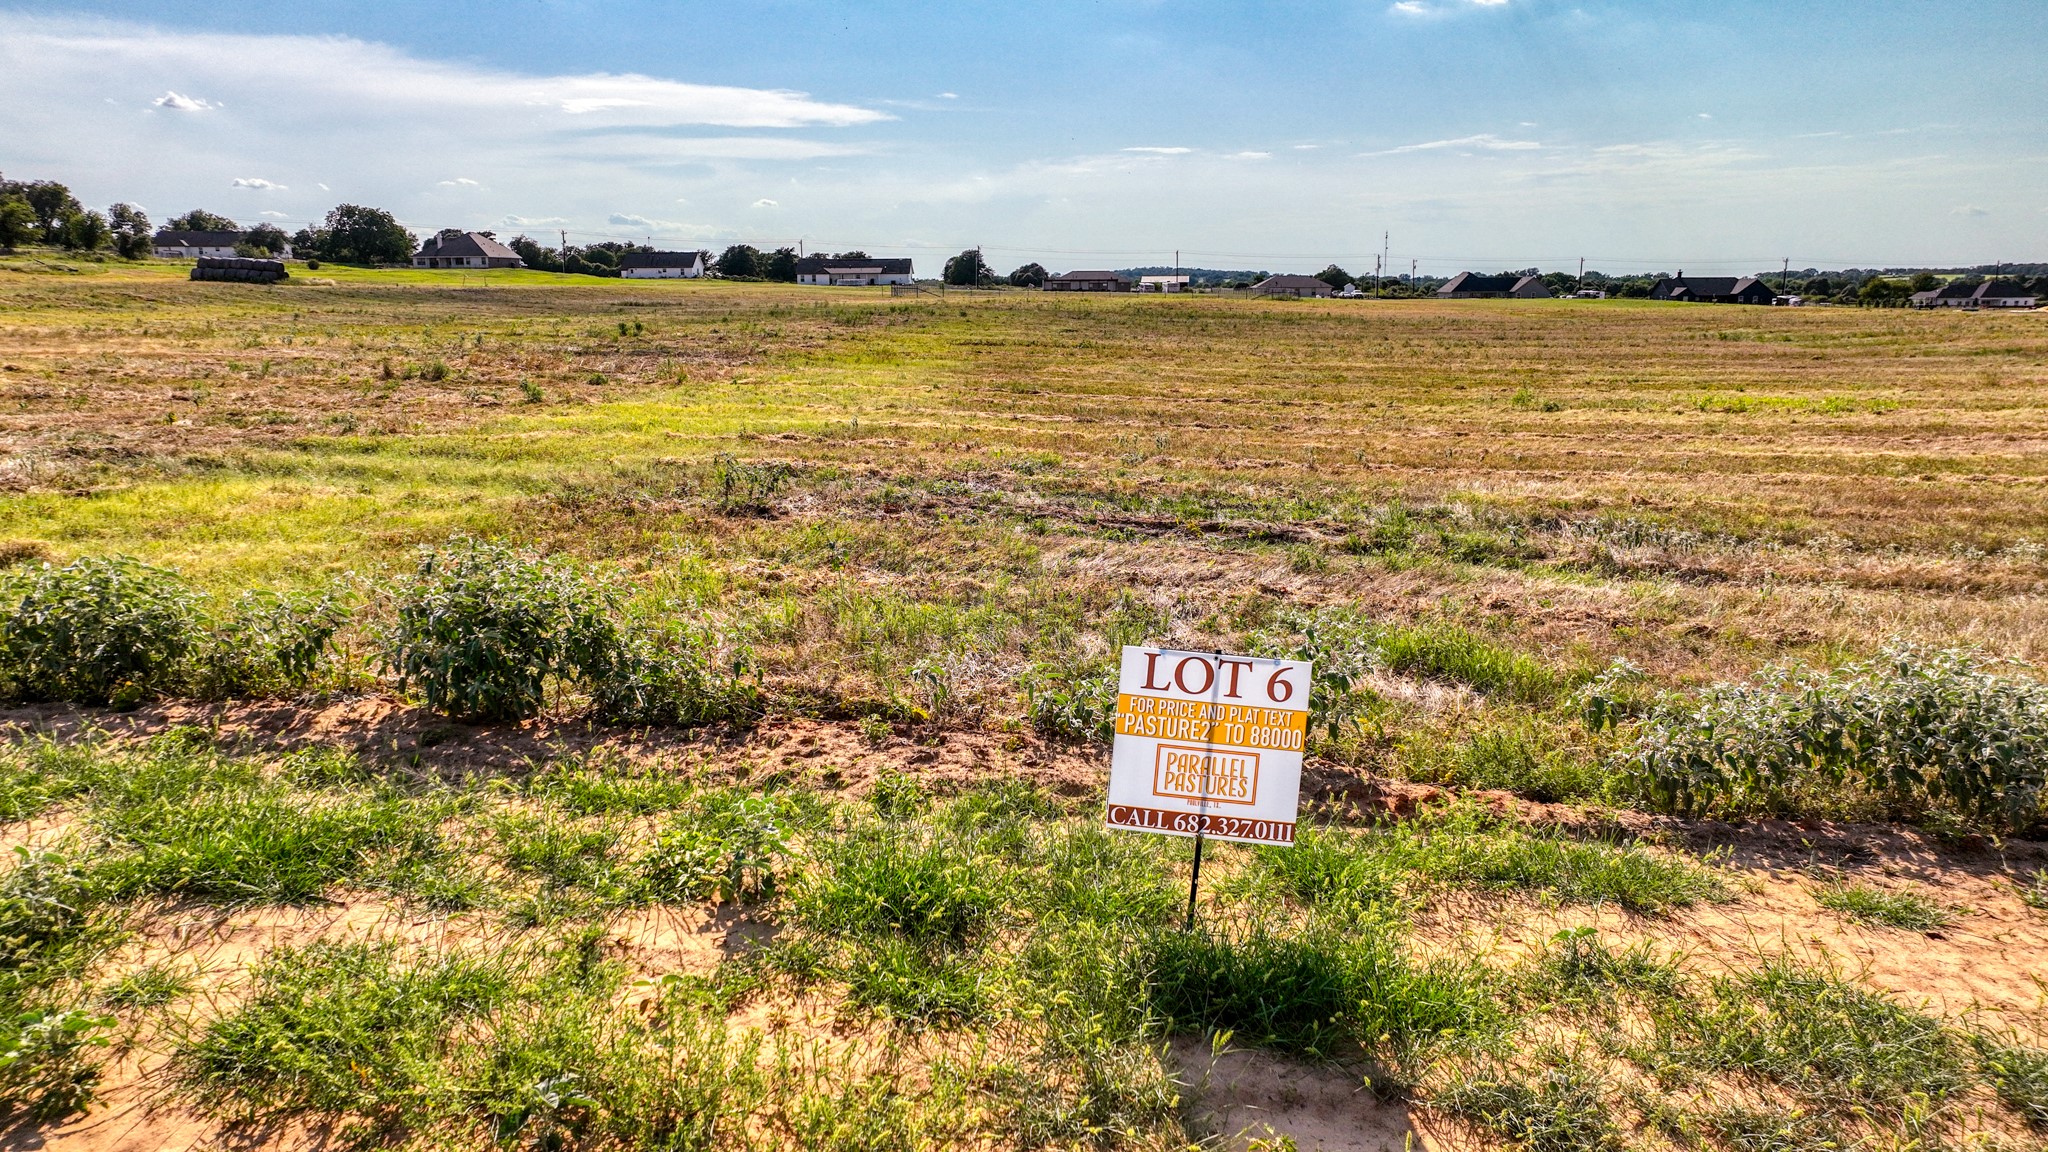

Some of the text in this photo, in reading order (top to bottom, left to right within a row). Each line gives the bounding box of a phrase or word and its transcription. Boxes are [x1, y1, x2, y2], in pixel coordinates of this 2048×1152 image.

[1140, 653, 1293, 702] LOT 6
[1130, 697, 1294, 727] FOR PRICE AND PLAT TEXT
[1225, 723, 1244, 744] TO
[1250, 727, 1302, 749] 88000
[1167, 752, 1248, 779] PARALLEL
[1164, 772, 1248, 798] PASTURES
[1110, 807, 1292, 842] CALL 682.327.0111
